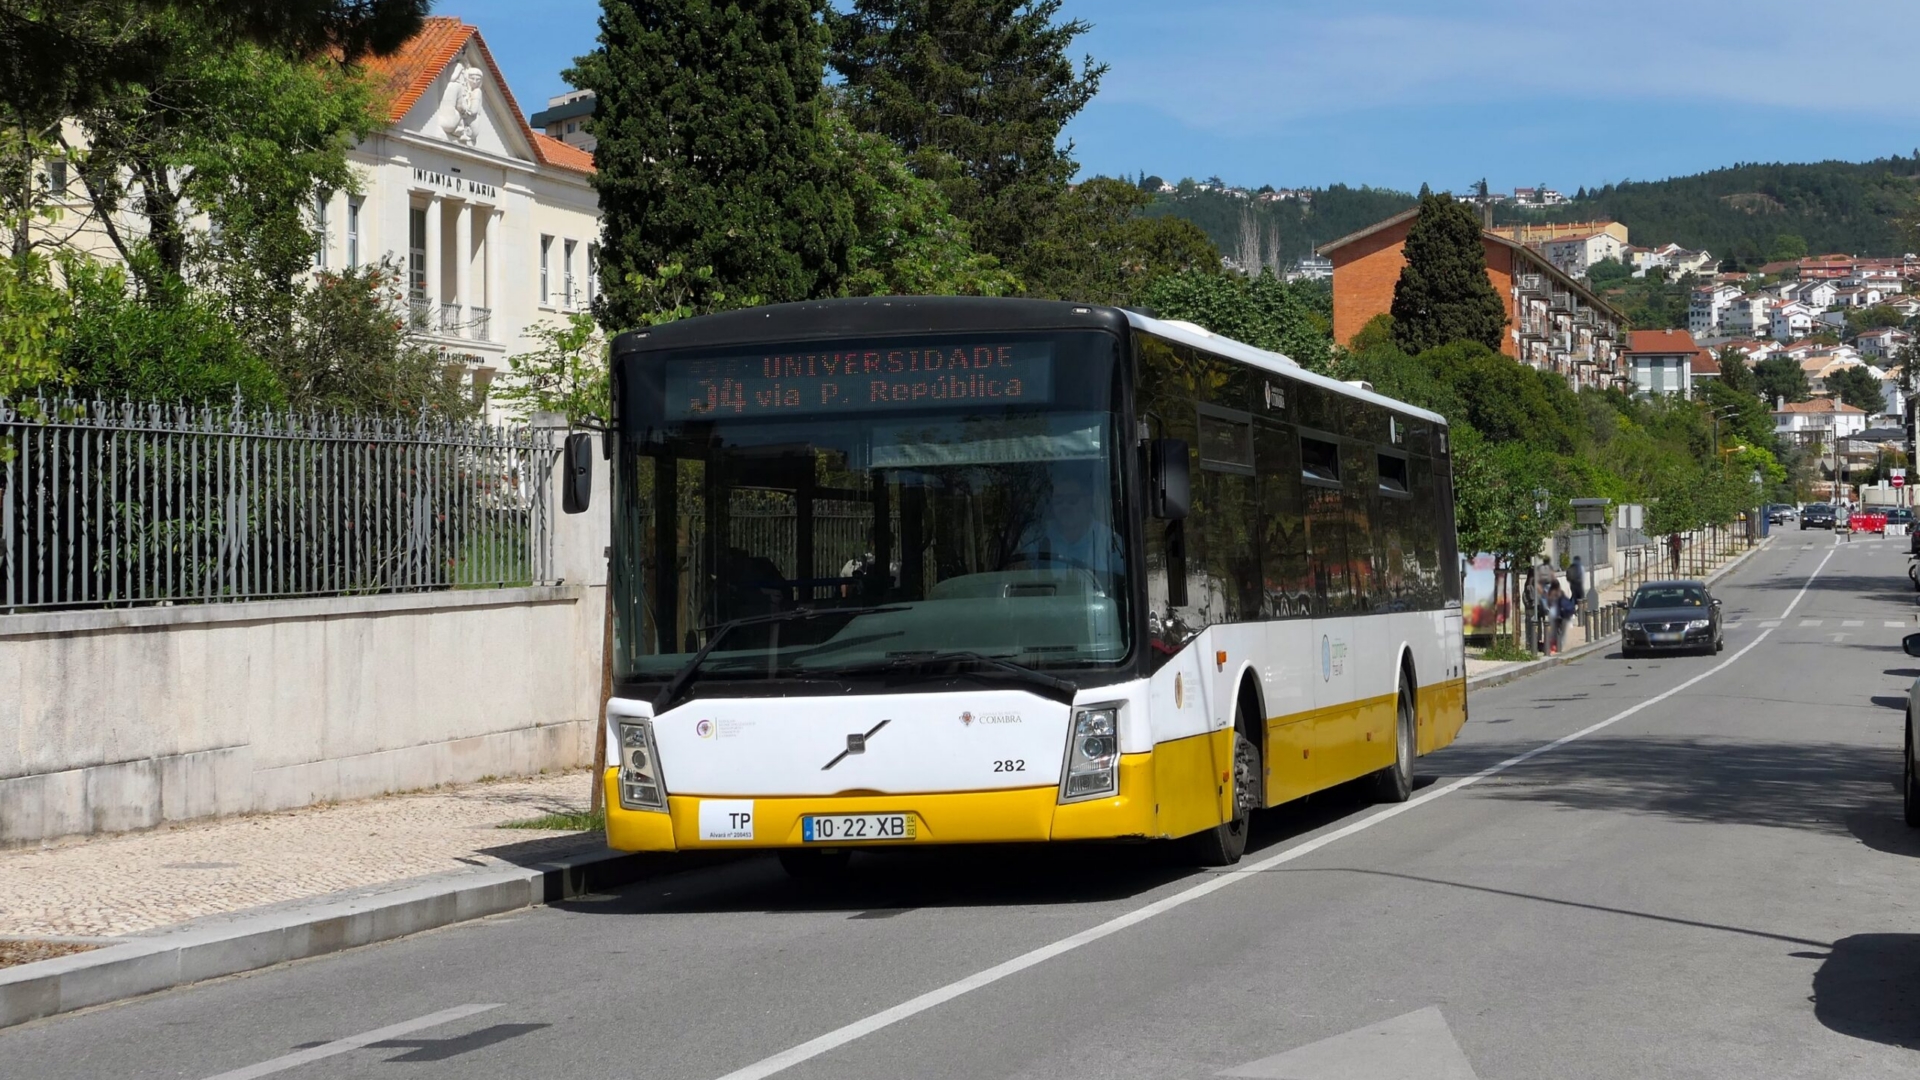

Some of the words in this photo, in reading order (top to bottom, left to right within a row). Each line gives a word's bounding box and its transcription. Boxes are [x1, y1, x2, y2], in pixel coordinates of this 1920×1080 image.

[413, 168, 452, 187] INFANTA
[469, 181, 496, 198] MARIA
[763, 346, 1012, 378] UNIVERSIDADE
[756, 383, 800, 407] via
[821, 383, 849, 404] P.
[871, 374, 1022, 402] República
[979, 715, 1022, 725] COIMBRA
[993, 759, 1026, 772] 282
[729, 813, 751, 829] TP
